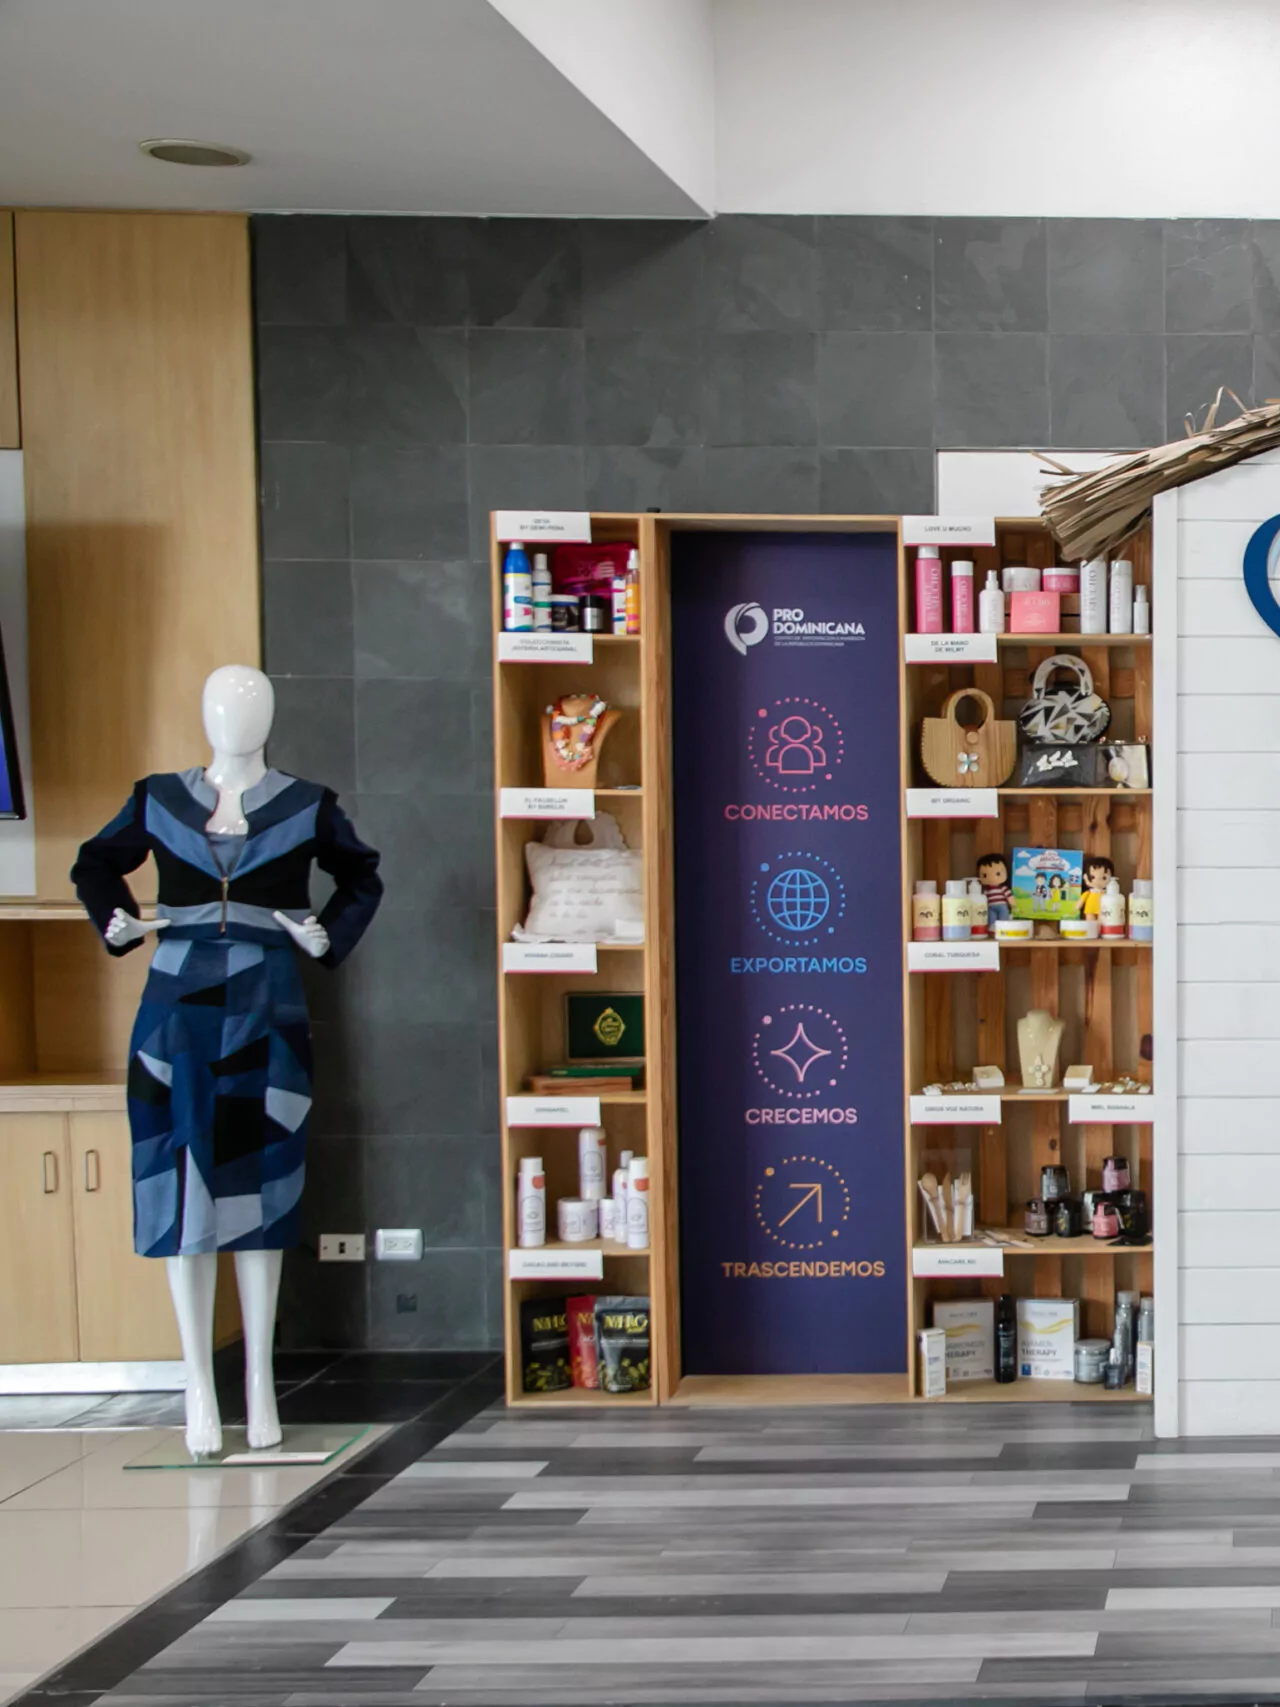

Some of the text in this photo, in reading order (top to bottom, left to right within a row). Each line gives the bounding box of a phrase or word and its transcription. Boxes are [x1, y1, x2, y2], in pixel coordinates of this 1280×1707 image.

[773, 608, 804, 622] PRO
[773, 622, 866, 635] DOMINICANA
[724, 803, 870, 821] CONECTAMOS
[730, 957, 868, 974] EXPORTAMOS
[744, 1107, 859, 1124] CRECEMOS
[721, 1260, 886, 1278] TRASCENDEMOS
